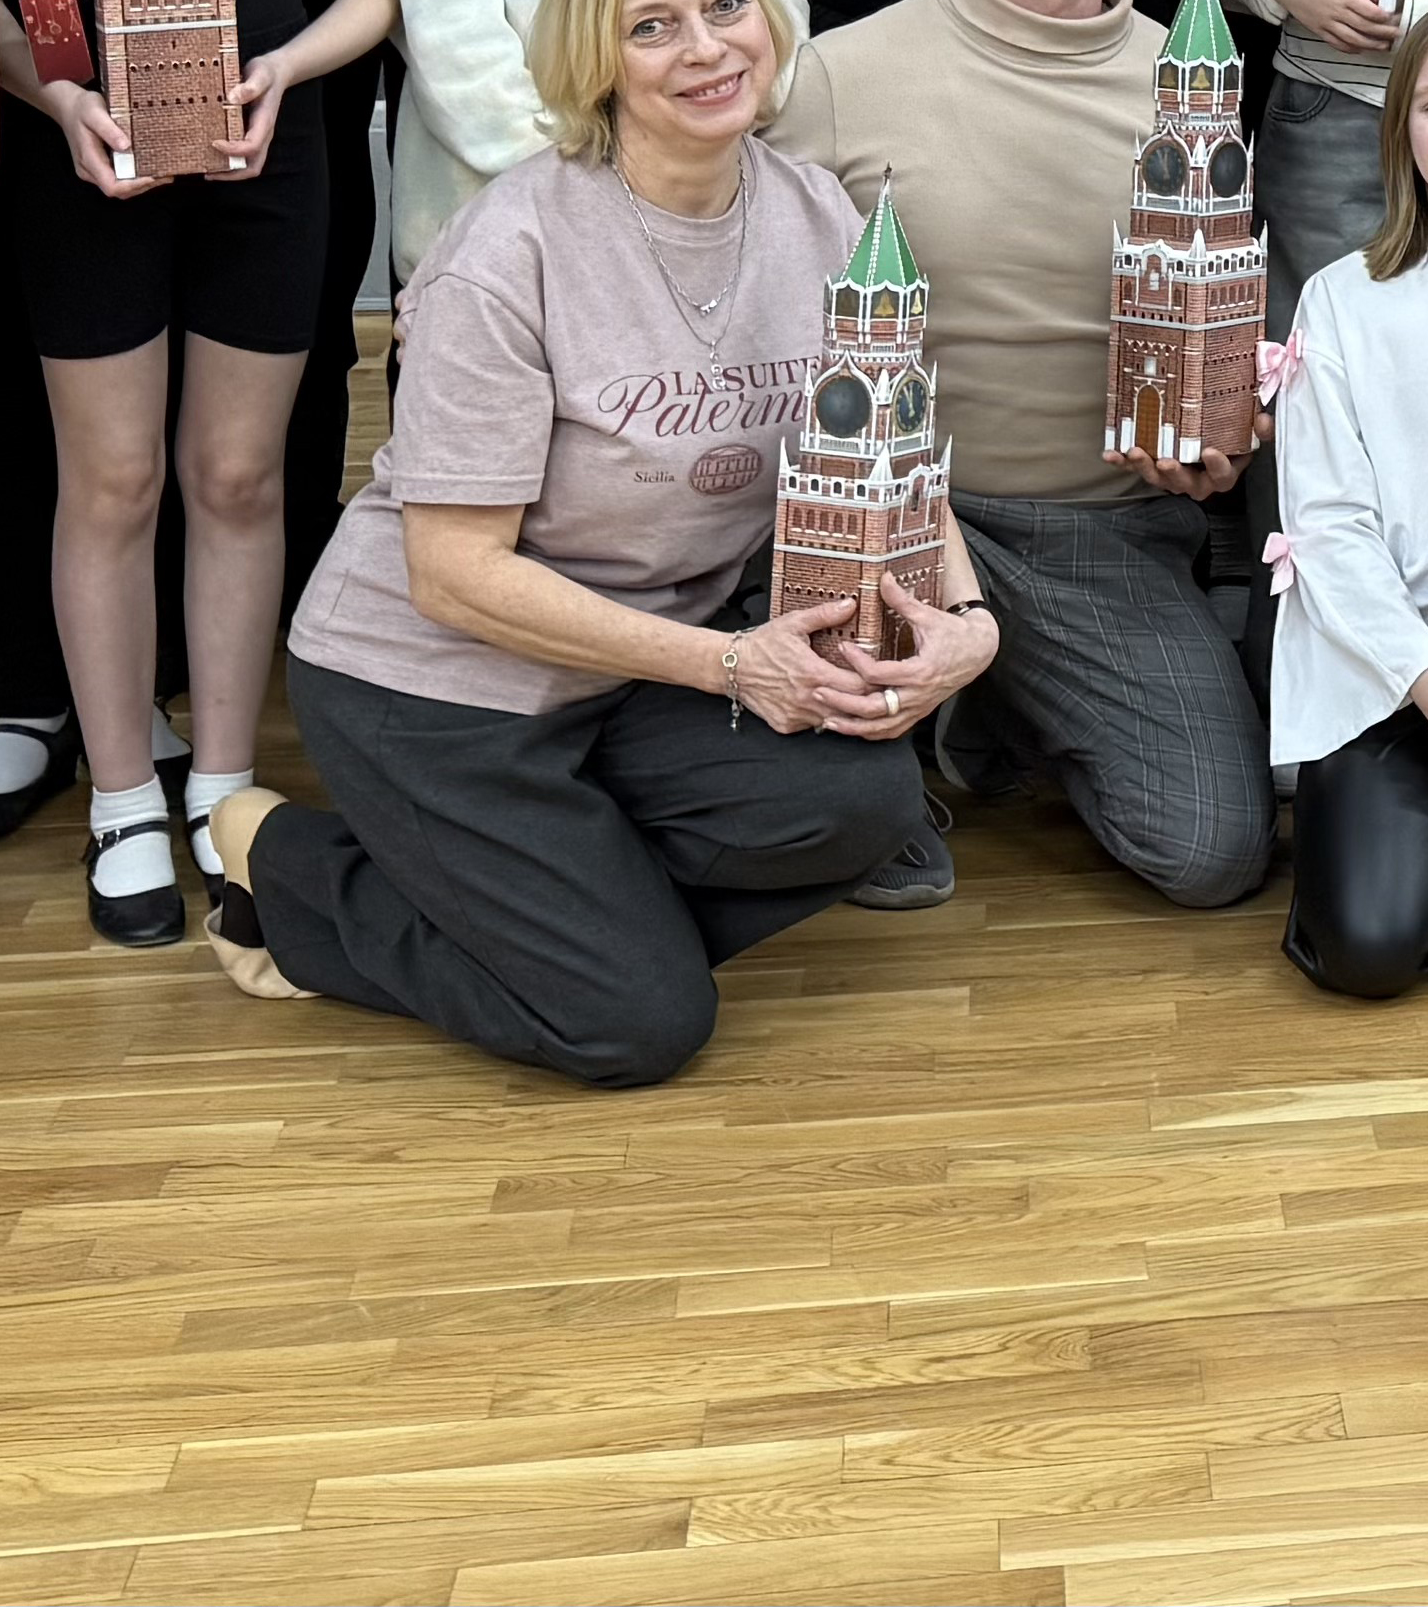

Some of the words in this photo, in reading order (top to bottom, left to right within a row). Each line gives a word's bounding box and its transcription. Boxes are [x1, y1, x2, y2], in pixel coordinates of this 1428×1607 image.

[671, 371, 713, 395] LA
[597, 370, 804, 438] Palerm
[633, 470, 677, 484] Sicilia
